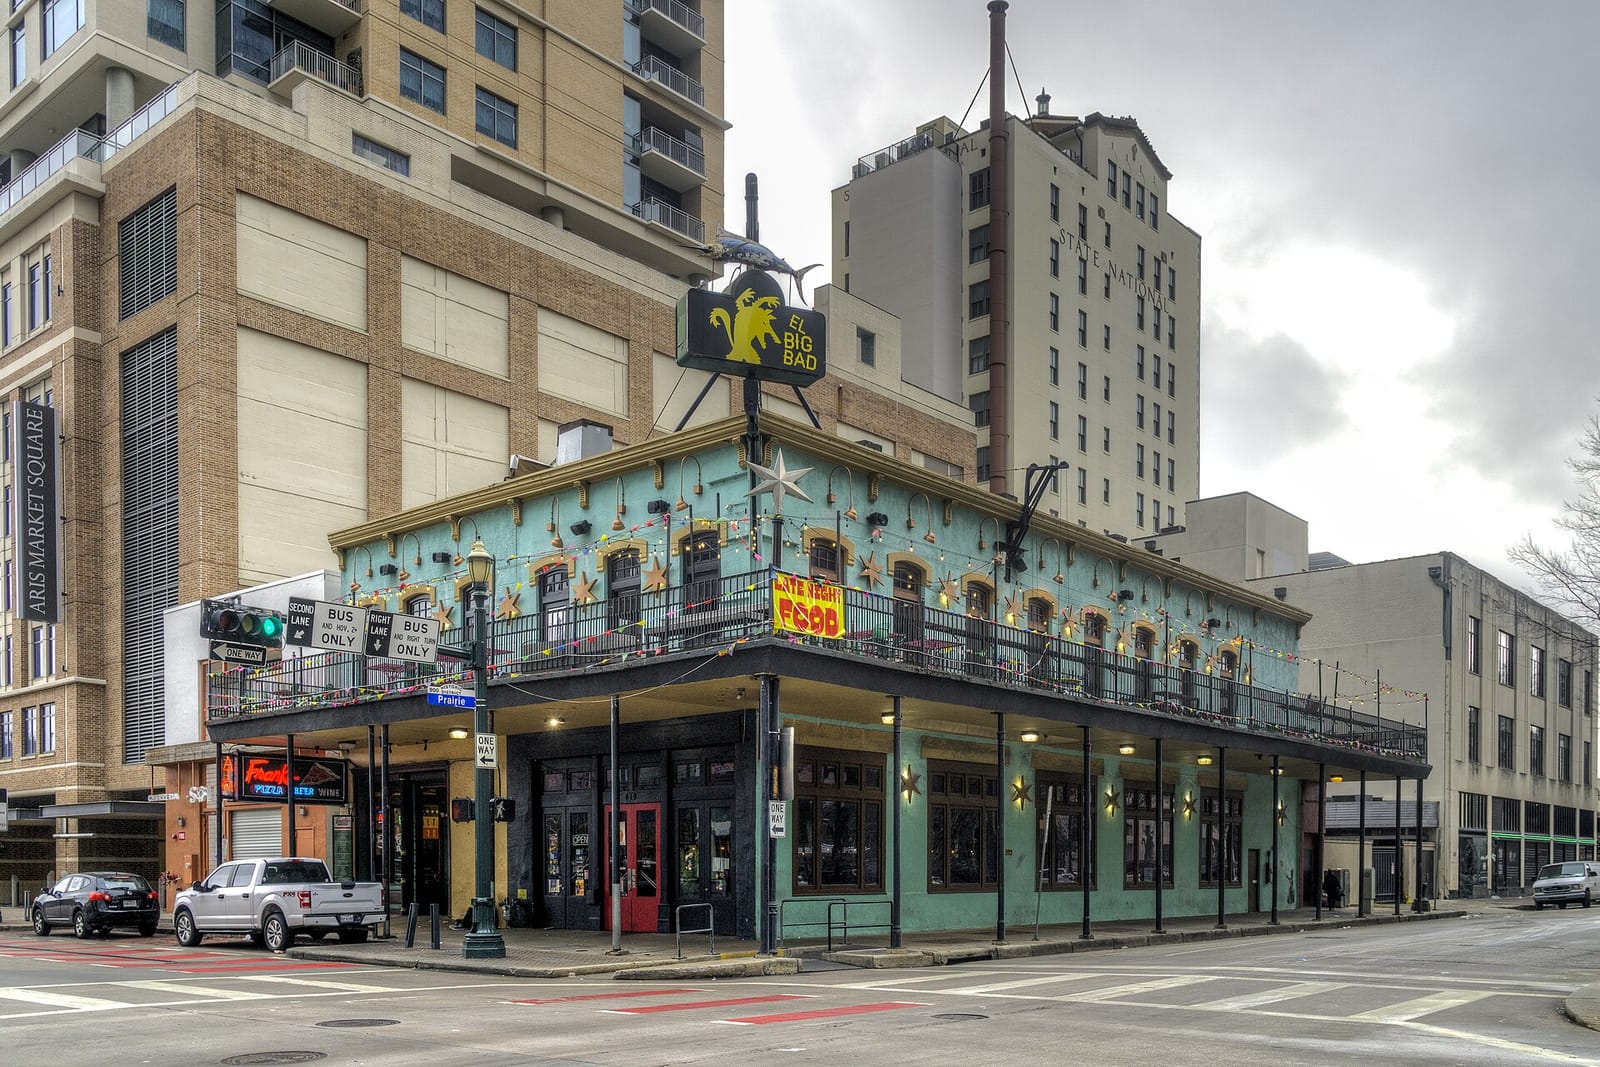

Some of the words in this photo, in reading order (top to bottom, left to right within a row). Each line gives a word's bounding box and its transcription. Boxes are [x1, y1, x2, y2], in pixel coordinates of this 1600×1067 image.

[1059, 228, 1100, 268] STATE
[1108, 259, 1169, 314] NATIONAL
[789, 313, 806, 335] EL
[784, 331, 813, 352] BIG
[783, 349, 817, 371] BAD
[26, 408, 46, 488] SQUARE
[27, 488, 45, 569] MARKET
[29, 571, 46, 615] ARIS
[774, 576, 804, 597] LATE
[807, 582, 842, 604] NIGHT
[289, 601, 315, 615] SECOND
[290, 615, 310, 626] LANE
[327, 608, 354, 622] BUS
[370, 613, 392, 625] RIGHT
[779, 597, 839, 637] FOOD
[321, 622, 333, 631] AND
[370, 625, 388, 637] LANE
[403, 621, 429, 634] BUS
[321, 633, 356, 647] ONLY
[393, 633, 404, 641] AND
[407, 634, 420, 643] RIGHT
[423, 636, 436, 645] TURN
[226, 648, 244, 658] ONE
[244, 649, 261, 660] WAY
[397, 643, 430, 658] ONLY
[437, 695, 466, 706] Prairie
[478, 736, 494, 745] ONE
[477, 746, 495, 755] WAY
[254, 784, 284, 795] PIZZA
[293, 786, 314, 796] BEER
[318, 788, 340, 797] WINE
[770, 803, 784, 813] ONE
[770, 815, 784, 824] WAY
